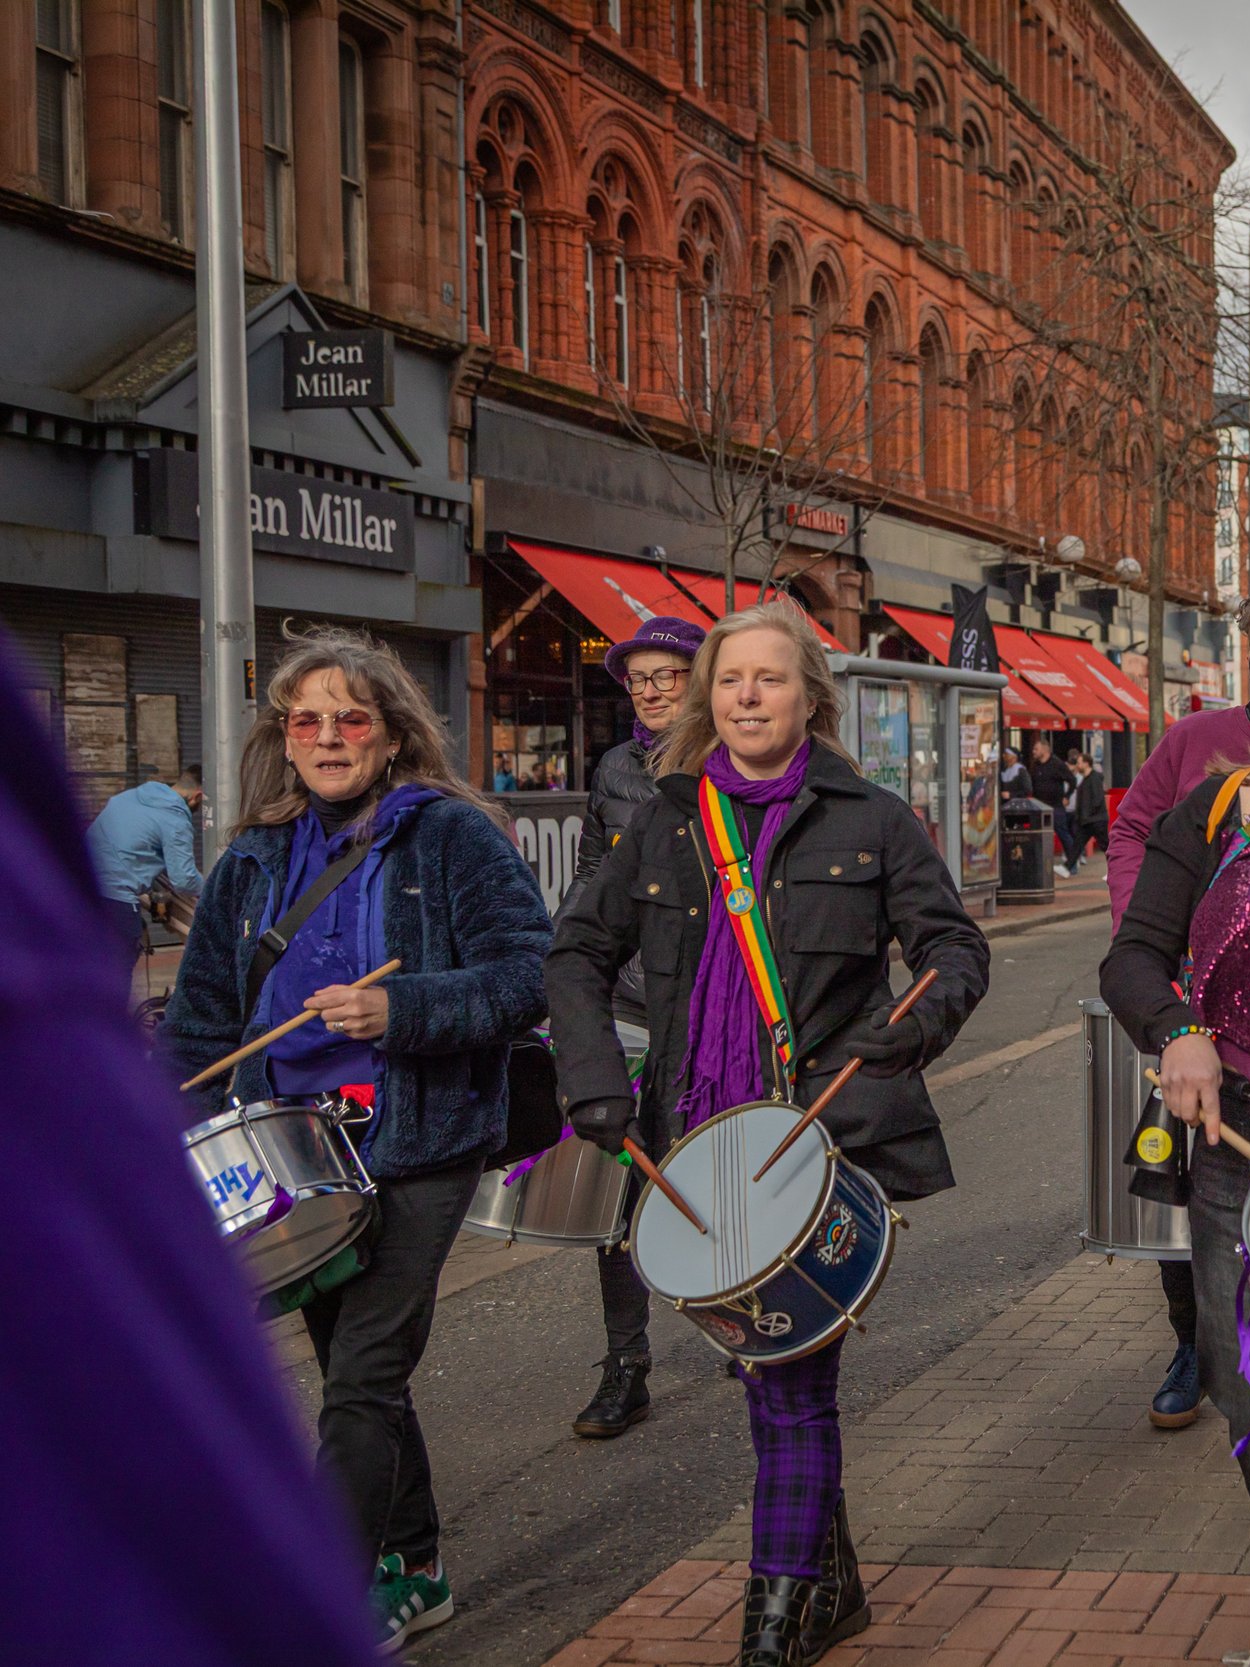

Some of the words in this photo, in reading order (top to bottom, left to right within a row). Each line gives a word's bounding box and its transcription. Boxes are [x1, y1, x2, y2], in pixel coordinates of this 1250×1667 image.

[301, 339, 364, 365] Jean
[296, 372, 372, 397] Millar
[250, 492, 290, 537] an
[298, 487, 398, 554] Millar
